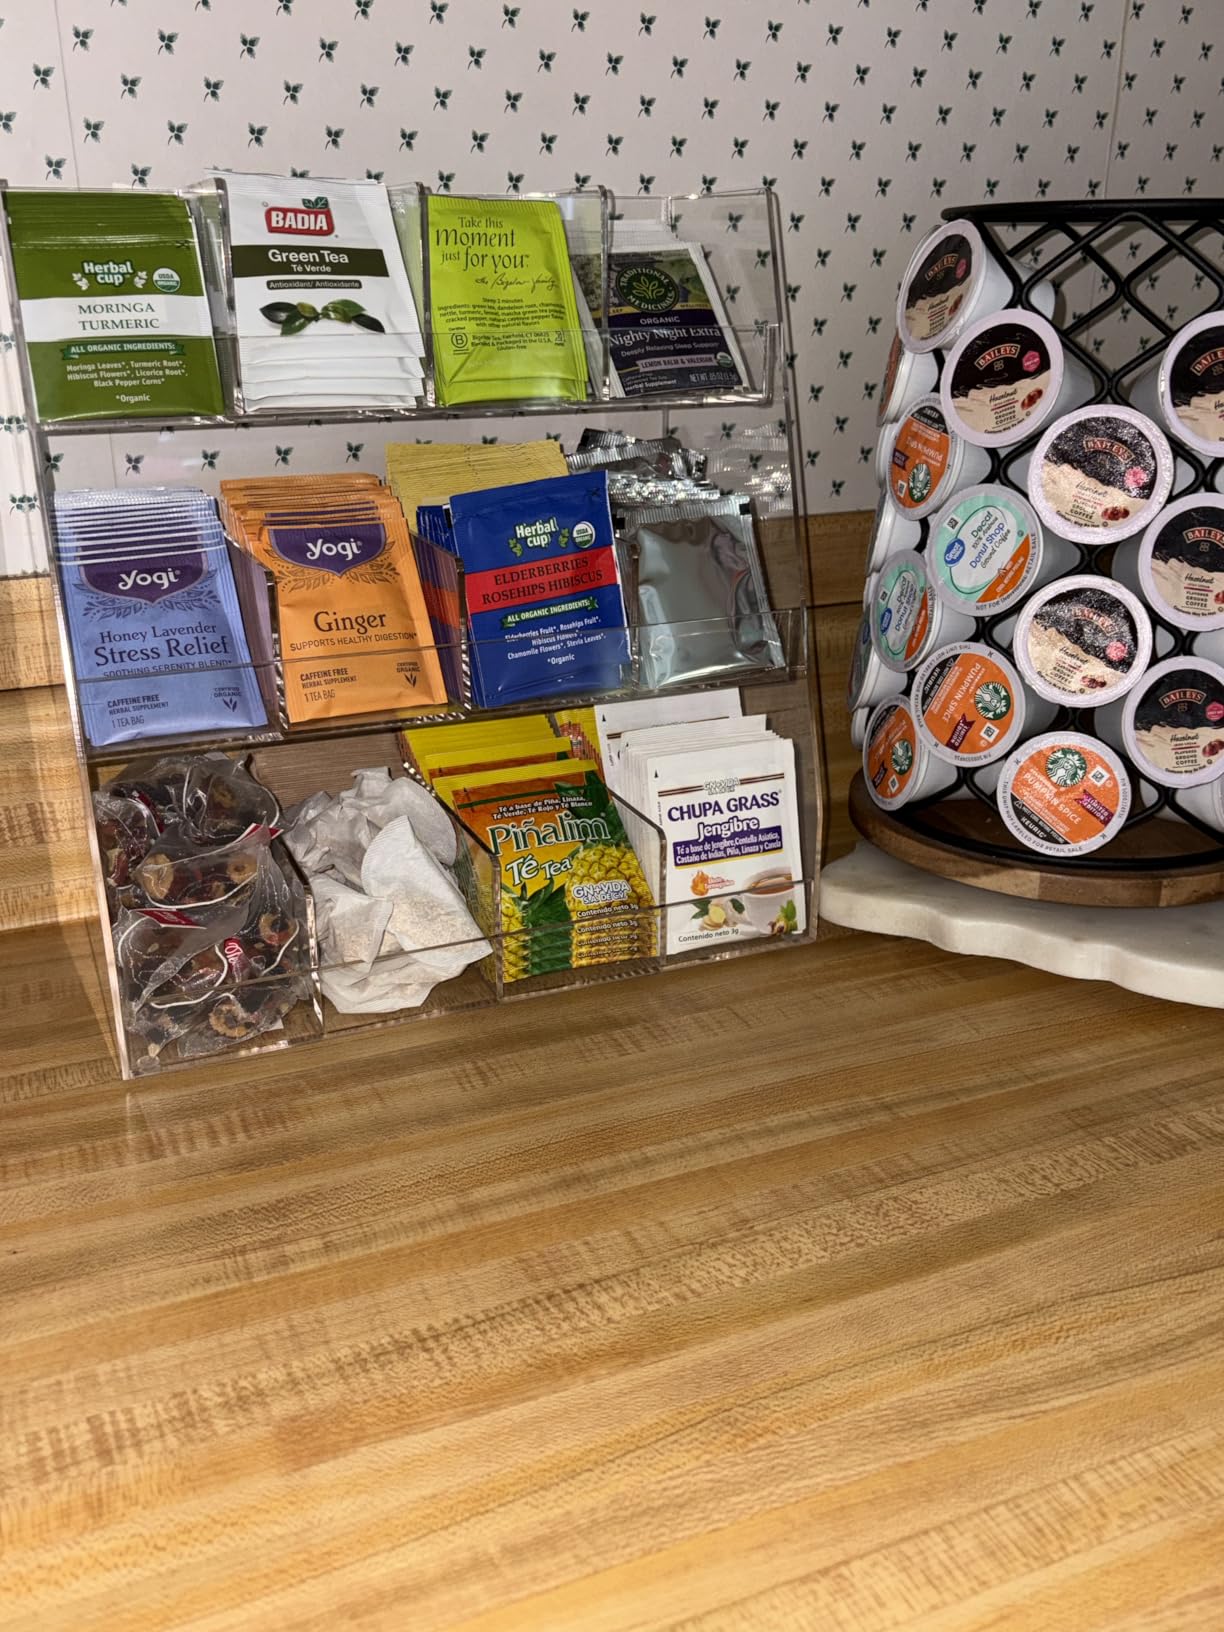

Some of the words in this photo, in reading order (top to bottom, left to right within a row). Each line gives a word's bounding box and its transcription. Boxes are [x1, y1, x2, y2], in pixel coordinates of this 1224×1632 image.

[271, 210, 328, 230] BADIA
[458, 216, 482, 228] Take
[486, 217, 504, 228] this
[436, 228, 516, 248] Moment
[268, 249, 319, 262] Green
[320, 250, 349, 264] Tea
[440, 250, 460, 264] just
[463, 246, 488, 272] for
[83, 261, 133, 274] Herbal
[291, 264, 303, 272] Té
[96, 273, 124, 286] cup
[270, 280, 313, 289] Antioxidant/
[316, 280, 360, 288] Antioxidante
[620, 267, 669, 286] TRADITIONAL
[78, 302, 155, 314] MORINGA
[627, 291, 676, 311] MEDICINALS
[78, 318, 160, 331] TURMERIC
[640, 316, 680, 325] ORGANIC
[456, 334, 464, 344] B
[654, 327, 688, 340] Night
[690, 326, 721, 337] Extra
[70, 345, 86, 354] ALL
[87, 343, 122, 352] ORGANIC
[123, 342, 176, 350] INGREDIENTS:
[979, 346, 1016, 366] BAILEYS
[66, 364, 96, 372] Moringa
[130, 360, 161, 368] Turmeric
[641, 358, 662, 368] LEMON
[687, 355, 714, 364] VALERIAN
[67, 372, 98, 380] Hibiscus
[136, 369, 163, 377] Licorice
[115, 379, 140, 388] Pepper
[996, 414, 1016, 425] COFFEE
[1088, 441, 1128, 460] BAILEYS
[516, 517, 559, 538] Herbal
[971, 511, 993, 538] Decaf
[306, 538, 360, 560] yogi
[527, 534, 551, 548] cup
[969, 543, 988, 568] Donut
[986, 522, 1005, 544] Shop
[981, 546, 996, 568] Ground
[995, 528, 1010, 549] Coffee
[118, 568, 178, 590] yogi
[494, 557, 589, 586] ELDERBERRIES
[1185, 572, 1214, 584] Hazelnut
[482, 584, 546, 605] ROSEHIPS
[549, 570, 602, 592] HIBISCUS
[976, 603, 986, 611] NOT
[988, 601, 1000, 609] FOR
[1025, 552, 1036, 574] RETAIL
[507, 614, 520, 622] ALL
[520, 609, 548, 620] ORGANIC
[550, 599, 590, 614] INGREDIENTS:
[314, 611, 386, 634] Ginger
[560, 621, 584, 631] Rosehips
[100, 631, 148, 644] Honey
[152, 622, 217, 638] Lavender
[532, 636, 556, 646] Hibiscus
[290, 638, 336, 652] SUPPORTS
[338, 635, 372, 646] HEALTHY
[508, 648, 538, 660] Chamomile
[567, 638, 583, 648] Stevia
[94, 645, 160, 668] Stress
[166, 636, 229, 658] Relief
[104, 667, 150, 679] SOOTHING
[152, 662, 198, 674] SERENITY
[300, 670, 332, 682] CAFFEINE
[332, 668, 348, 678] FREE
[302, 679, 322, 689] HERBAL
[324, 675, 358, 686] SUPPLEMENT
[924, 668, 940, 694] KEURIG
[956, 662, 982, 701] PUMPKIN
[107, 695, 142, 708] CAFFEINE
[142, 694, 160, 704] FREE
[310, 691, 322, 702] TEA
[324, 689, 336, 700] BAG
[1164, 692, 1202, 704] BAILEYS
[109, 705, 131, 716] HERBAL
[133, 702, 168, 712] SUPPLEMENT
[117, 717, 130, 728] TEA
[130, 715, 144, 726] BAG
[1170, 733, 1200, 742] Hazelnut
[514, 802, 533, 810] base
[534, 800, 543, 808] de
[544, 797, 561, 806] Piña,
[562, 796, 586, 804] Linaza,
[1023, 772, 1058, 806] PUMPKIN
[1059, 802, 1082, 824] SPICE
[493, 812, 502, 820] Té
[504, 809, 526, 818] Verde,
[528, 806, 537, 814] Té
[538, 804, 554, 814] Rojo
[561, 802, 570, 810] Té
[570, 800, 592, 808] Blanco
[668, 800, 724, 822] CHUPA
[727, 792, 780, 813] GRASS
[1087, 796, 1108, 817] LIMITED
[486, 811, 611, 856] Piñalim
[698, 816, 760, 842] Jengibre
[1021, 817, 1044, 838] KEURIG
[676, 846, 684, 854] Té
[690, 844, 704, 852] base
[676, 854, 700, 864] Castaño
[701, 852, 708, 861] de
[708, 850, 726, 860] Indias,
[727, 847, 741, 858] Piña,
[742, 845, 759, 854] Linaza
[764, 841, 781, 850] Canela
[1032, 840, 1044, 849] FOR
[1045, 845, 1066, 854] RETAIL
[506, 854, 540, 886] Té
[540, 857, 572, 880] Tea
[573, 881, 631, 898] GN+VIDA
[602, 893, 611, 902] DE
[577, 906, 612, 918] Contenido
[614, 904, 628, 912] neto
[678, 930, 713, 942] Contenido
[715, 929, 730, 937] neto
